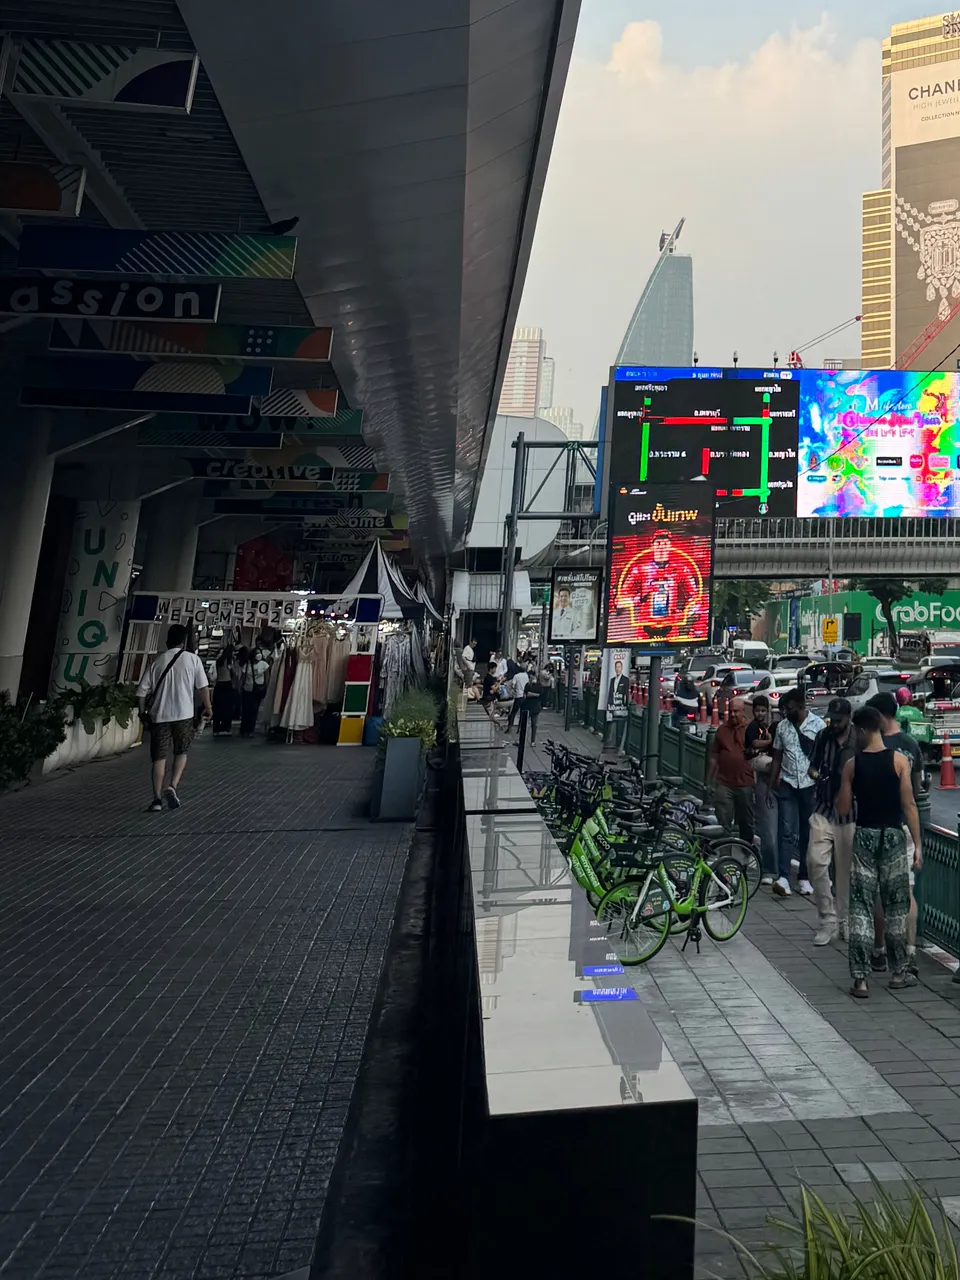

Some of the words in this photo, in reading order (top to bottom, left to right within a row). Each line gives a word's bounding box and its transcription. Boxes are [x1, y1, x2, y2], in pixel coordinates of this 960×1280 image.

[913, 101, 933, 111] HIGH
[921, 111, 955, 122] COLLECTION
[567, 442, 578, 450] 24
[206, 458, 321, 481] creative
